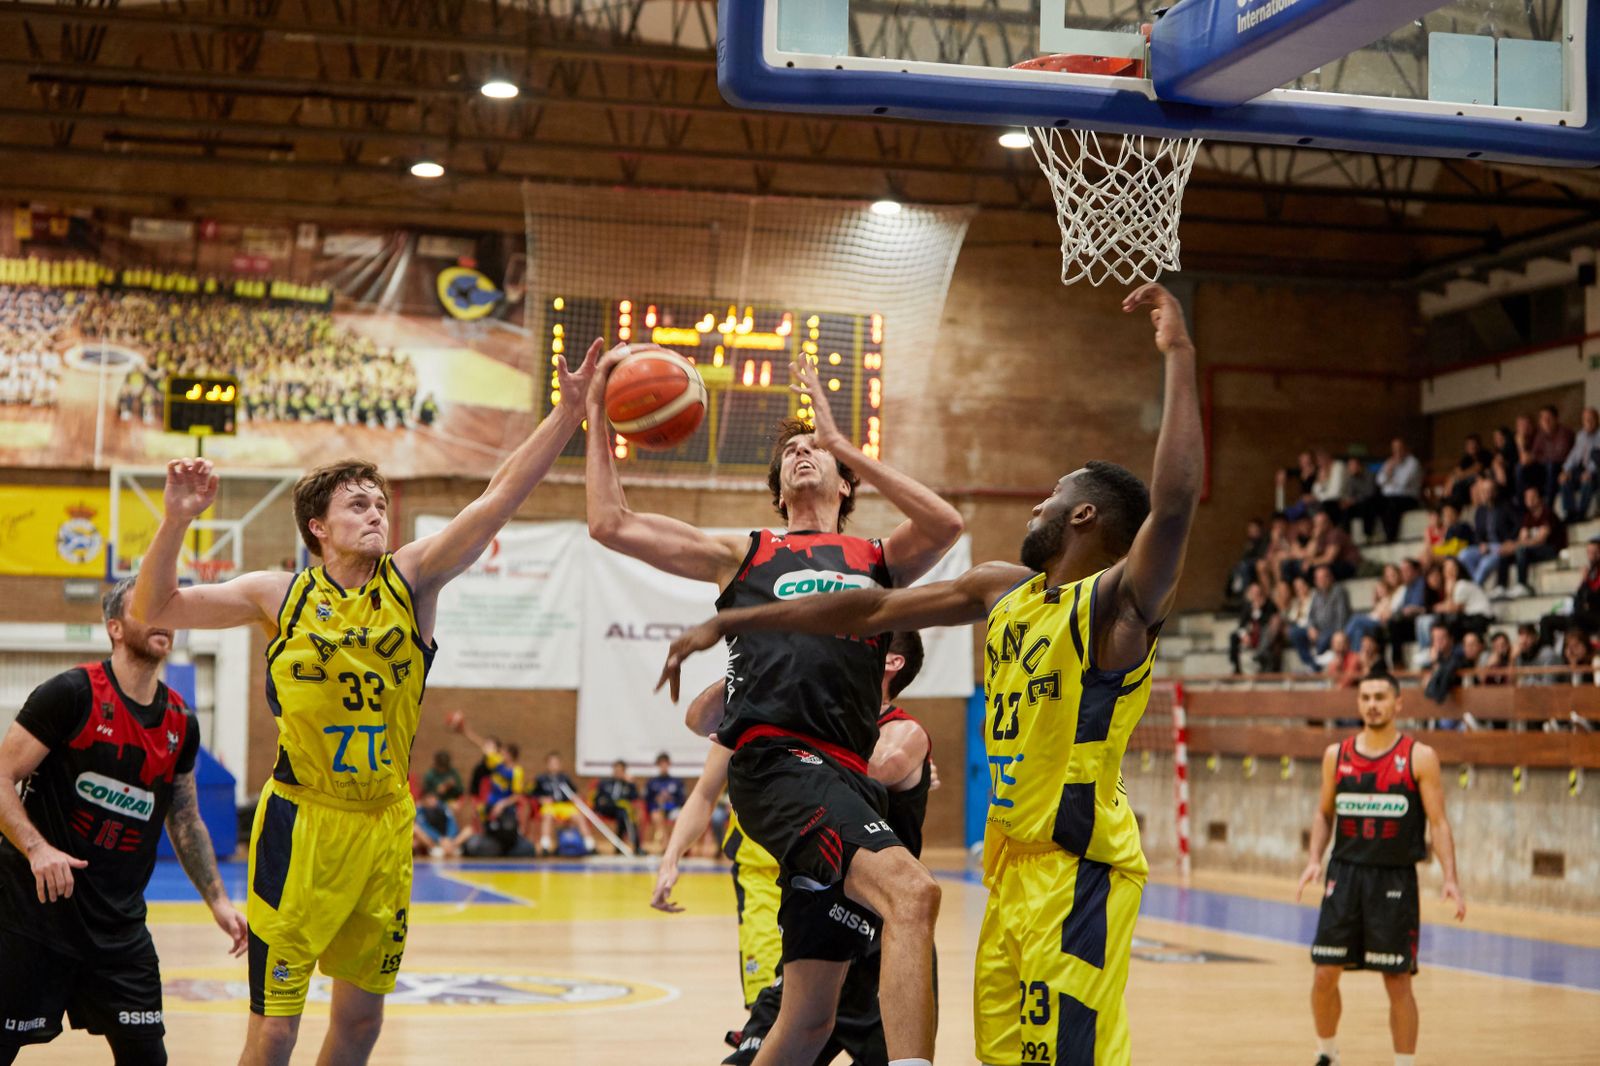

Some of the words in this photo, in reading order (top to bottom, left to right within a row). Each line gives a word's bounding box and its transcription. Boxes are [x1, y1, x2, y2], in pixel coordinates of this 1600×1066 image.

[778, 574, 862, 597] COVI
[605, 623, 700, 641] ALCO
[985, 620, 1062, 707] ANOE
[338, 671, 385, 712] 33
[992, 691, 1022, 741] 23
[94, 819, 123, 850] 15
